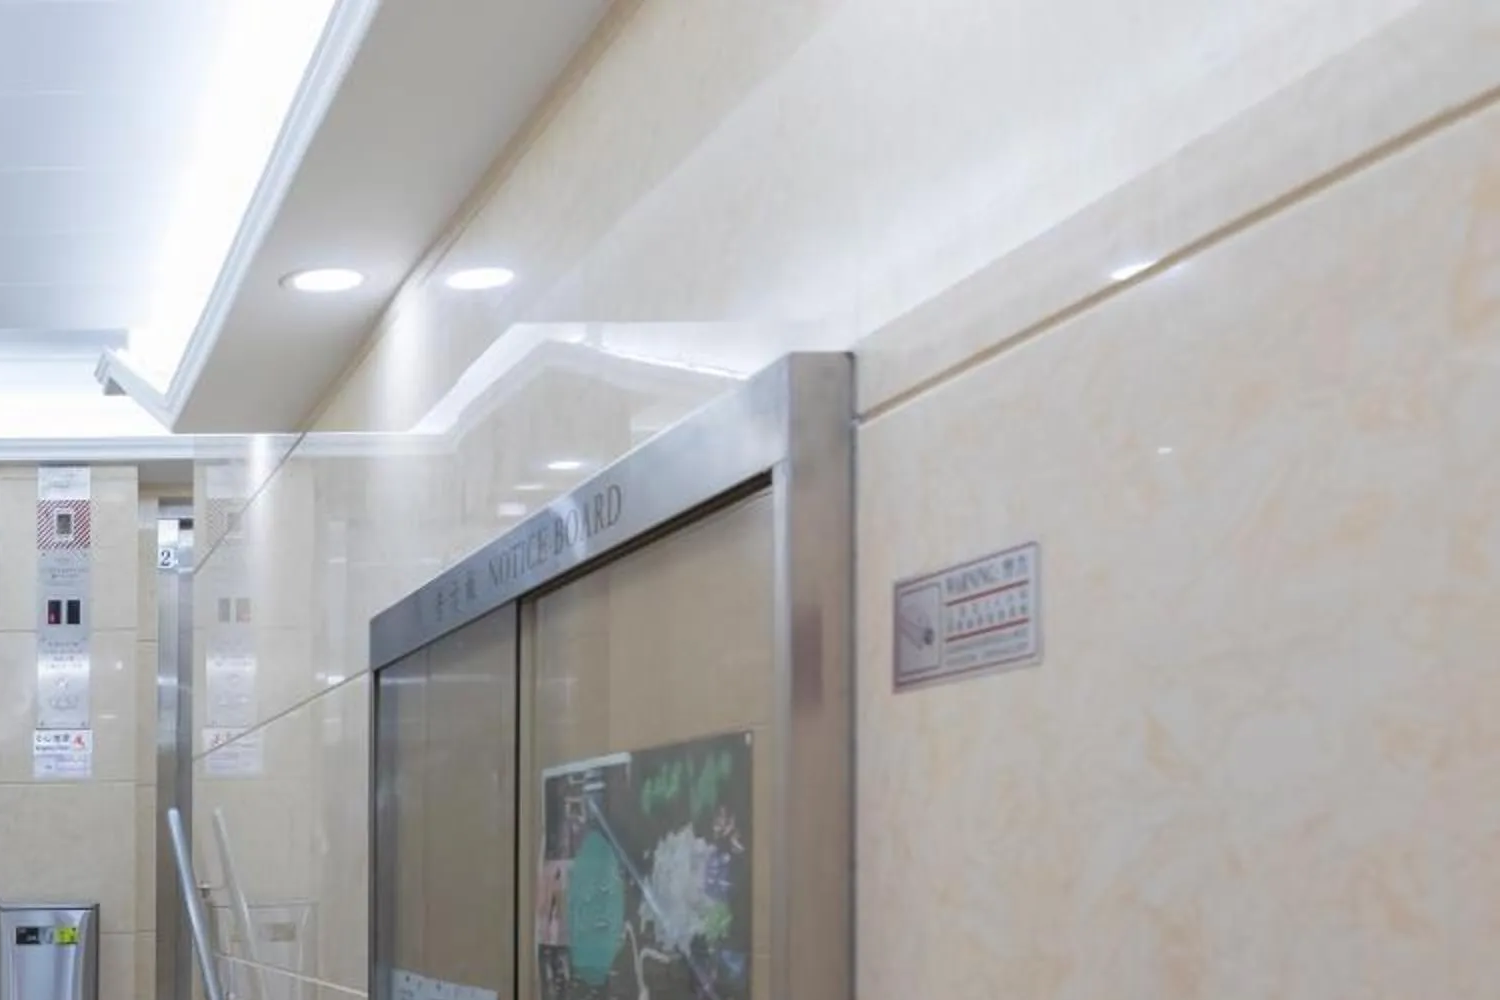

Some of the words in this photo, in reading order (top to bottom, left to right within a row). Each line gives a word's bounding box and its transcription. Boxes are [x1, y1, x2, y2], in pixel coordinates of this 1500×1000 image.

[160, 550, 171, 566] 2
[488, 525, 549, 587] NOTICE
[553, 484, 622, 555] BOARD
